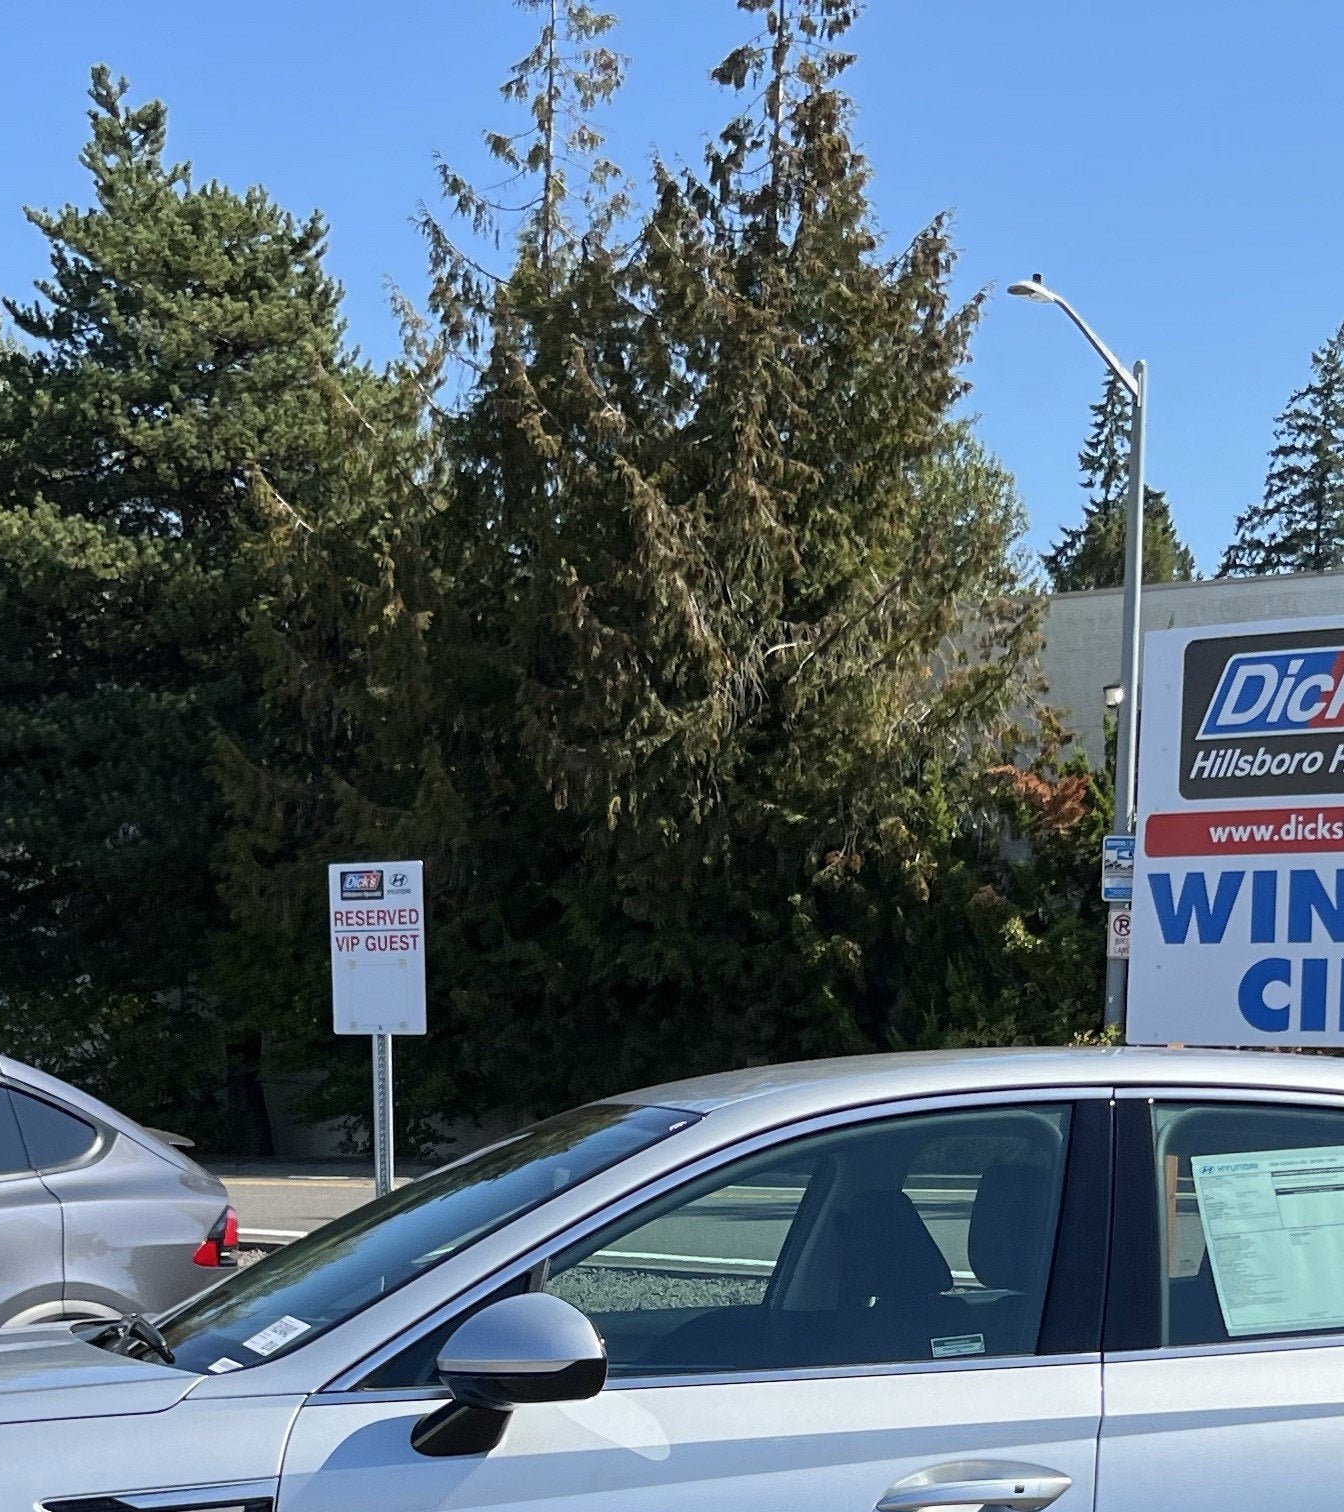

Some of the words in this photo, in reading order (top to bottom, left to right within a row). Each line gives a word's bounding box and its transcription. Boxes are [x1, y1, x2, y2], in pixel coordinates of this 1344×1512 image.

[1189, 747, 1323, 780] Hillsboro
[334, 908, 419, 927] RESERVED
[335, 935, 360, 952] VIP
[365, 934, 419, 952] GUEST
